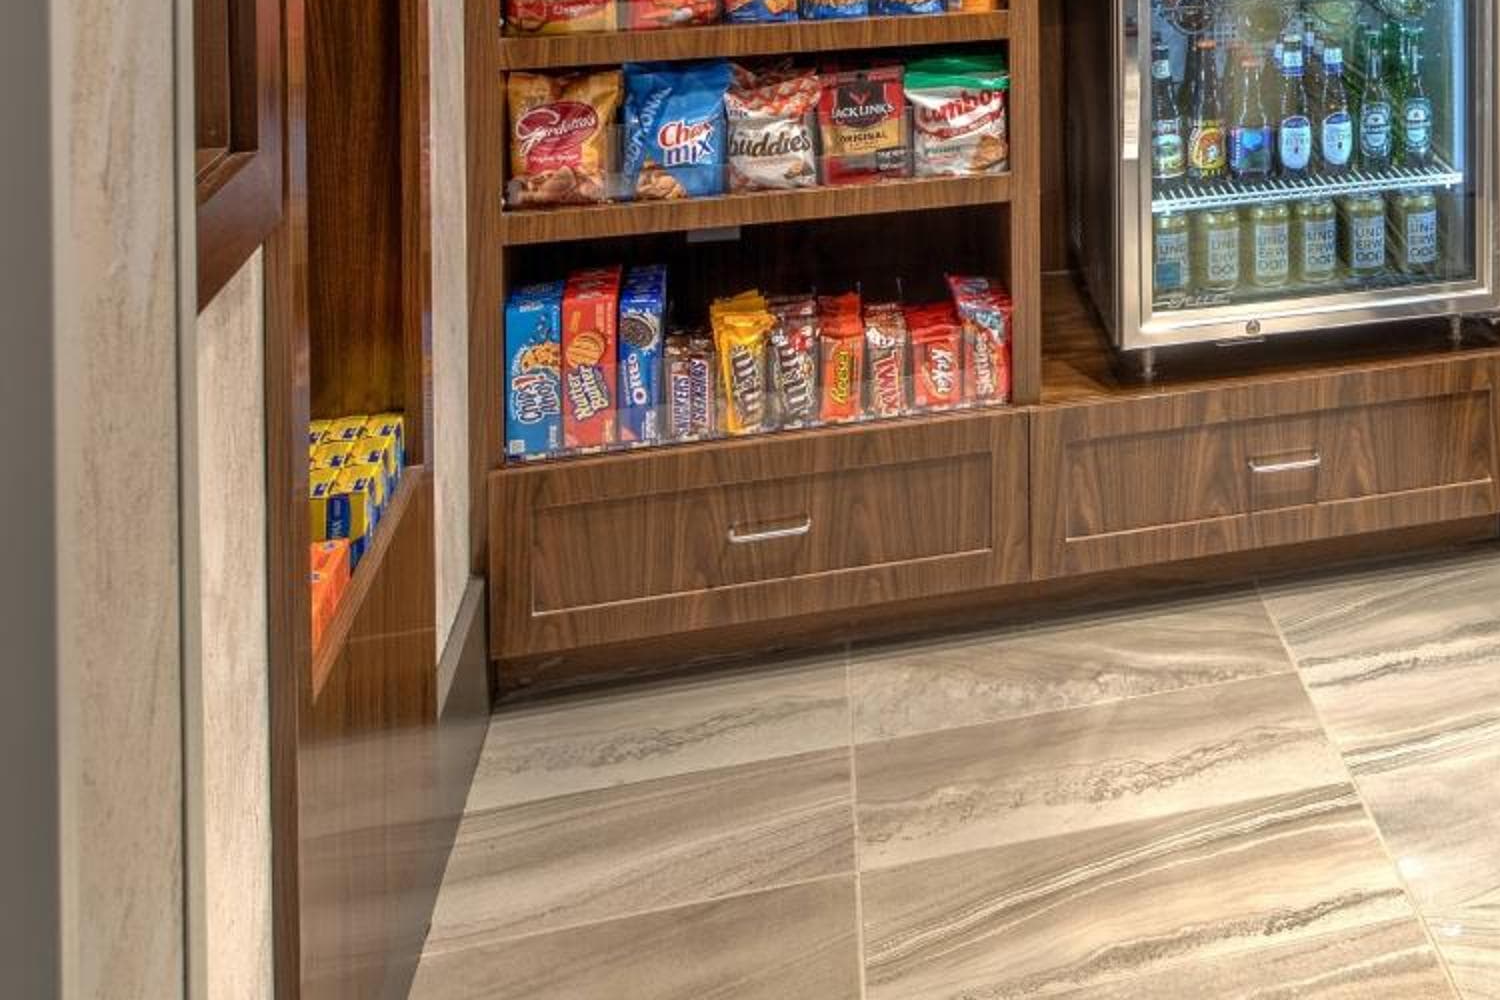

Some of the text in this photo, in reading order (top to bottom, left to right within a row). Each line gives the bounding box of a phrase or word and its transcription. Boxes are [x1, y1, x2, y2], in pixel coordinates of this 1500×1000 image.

[728, 129, 811, 157] buddies
[567, 373, 592, 421] Nutter
[579, 365, 609, 411] Butter
[627, 353, 647, 405] OREO
